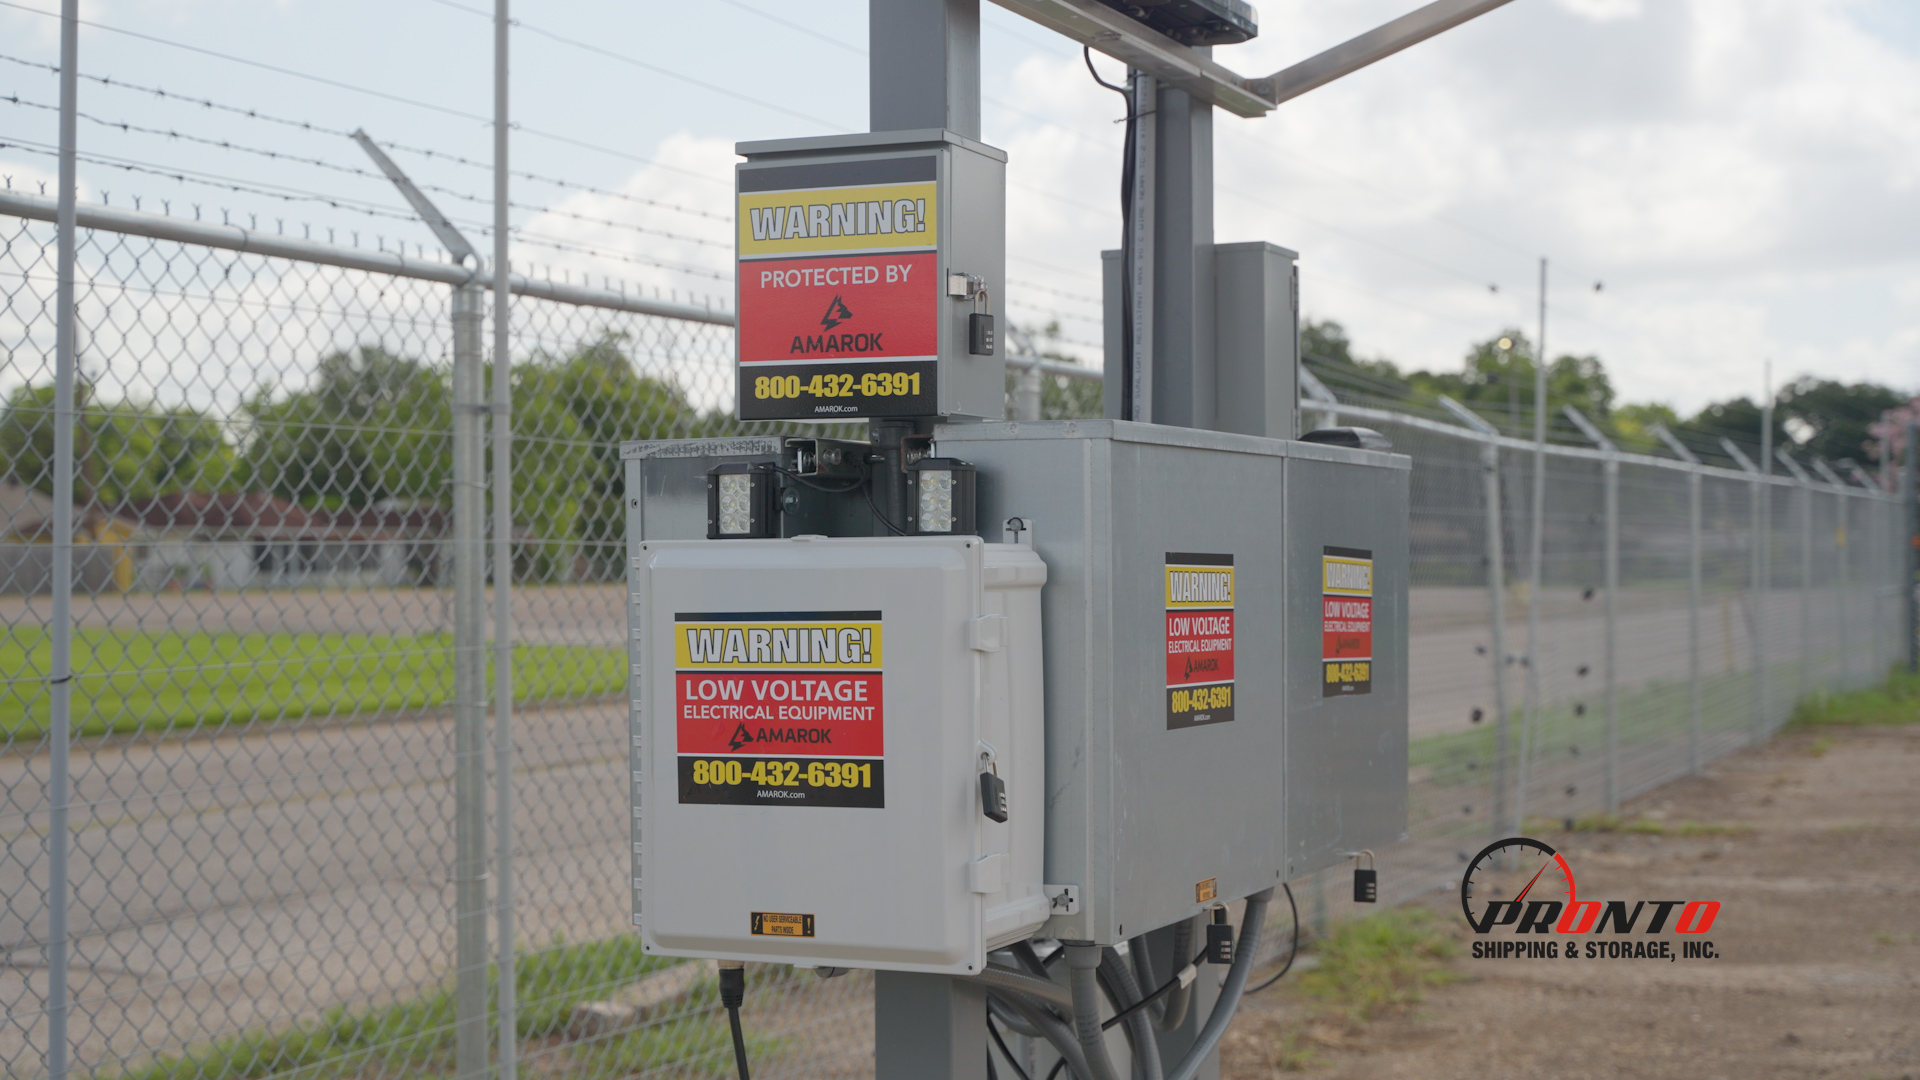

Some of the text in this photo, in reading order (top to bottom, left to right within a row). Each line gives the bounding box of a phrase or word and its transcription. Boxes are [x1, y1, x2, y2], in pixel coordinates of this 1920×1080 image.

[750, 198, 926, 241] WARNING!
[760, 264, 912, 288] PROTECTED BY
[1135, 291, 1143, 345] RESISTANT
[790, 333, 883, 354] AMAROK
[755, 372, 920, 399] 800-432-6391
[814, 405, 858, 413] AMAROK.com
[1326, 561, 1370, 591] WARNING!
[1169, 571, 1231, 603] WARNING!
[1325, 601, 1369, 619] LOW VOLTAGE
[1169, 617, 1230, 636] LOW VOLTAGE
[686, 628, 872, 664] WARNING!
[1169, 638, 1232, 654] ELECTRICAL EQUIPMENT
[1193, 658, 1219, 672] AMAROK
[686, 680, 868, 701] LOW VOLTAGE
[1172, 686, 1231, 713] 800-432-6391
[683, 705, 875, 721] ELECTRICAL EQUIPMENT
[756, 728, 832, 743] AMAROK
[693, 760, 871, 788] 800-432-6391
[757, 790, 805, 799] AMAROK.com
[783, 926, 794, 934] INSIDE
